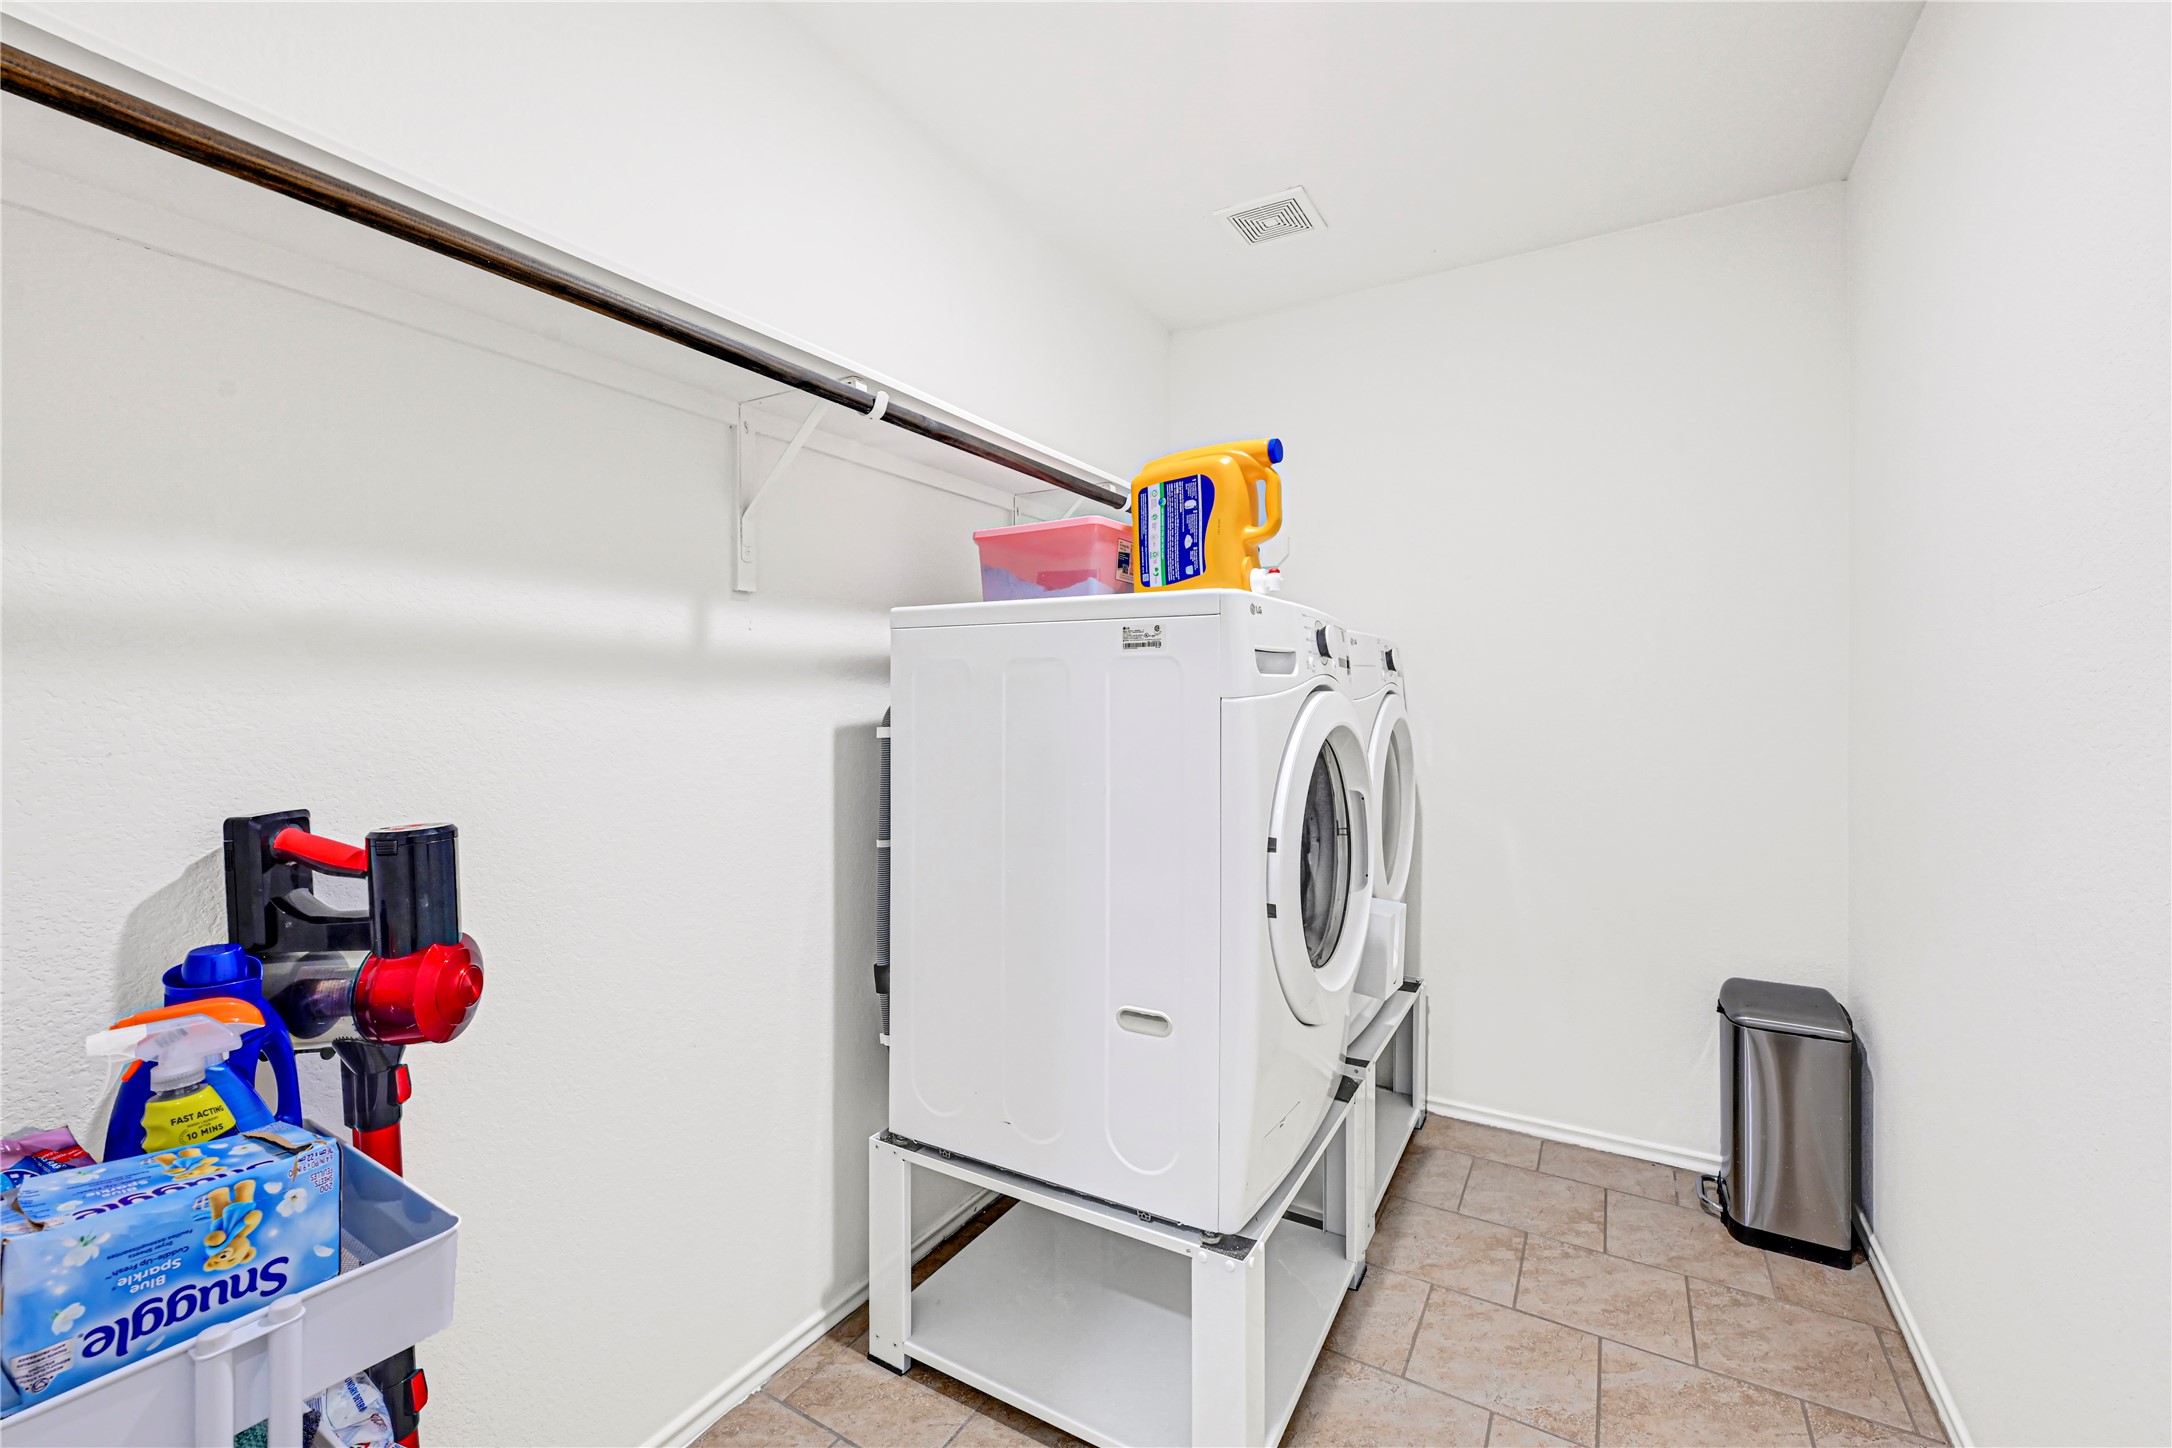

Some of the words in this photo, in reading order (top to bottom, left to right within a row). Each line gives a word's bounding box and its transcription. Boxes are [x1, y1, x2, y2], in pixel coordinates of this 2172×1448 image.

[170, 1114, 194, 1126] FAST
[196, 1105, 224, 1119] ACTING
[187, 1132, 198, 1140] 10
[200, 1124, 224, 1136] MINS
[320, 1182, 333, 1193] 200
[116, 1258, 182, 1286] Sparkle
[130, 1274, 166, 1294] Blue
[82, 1256, 290, 1358] Snuggle
